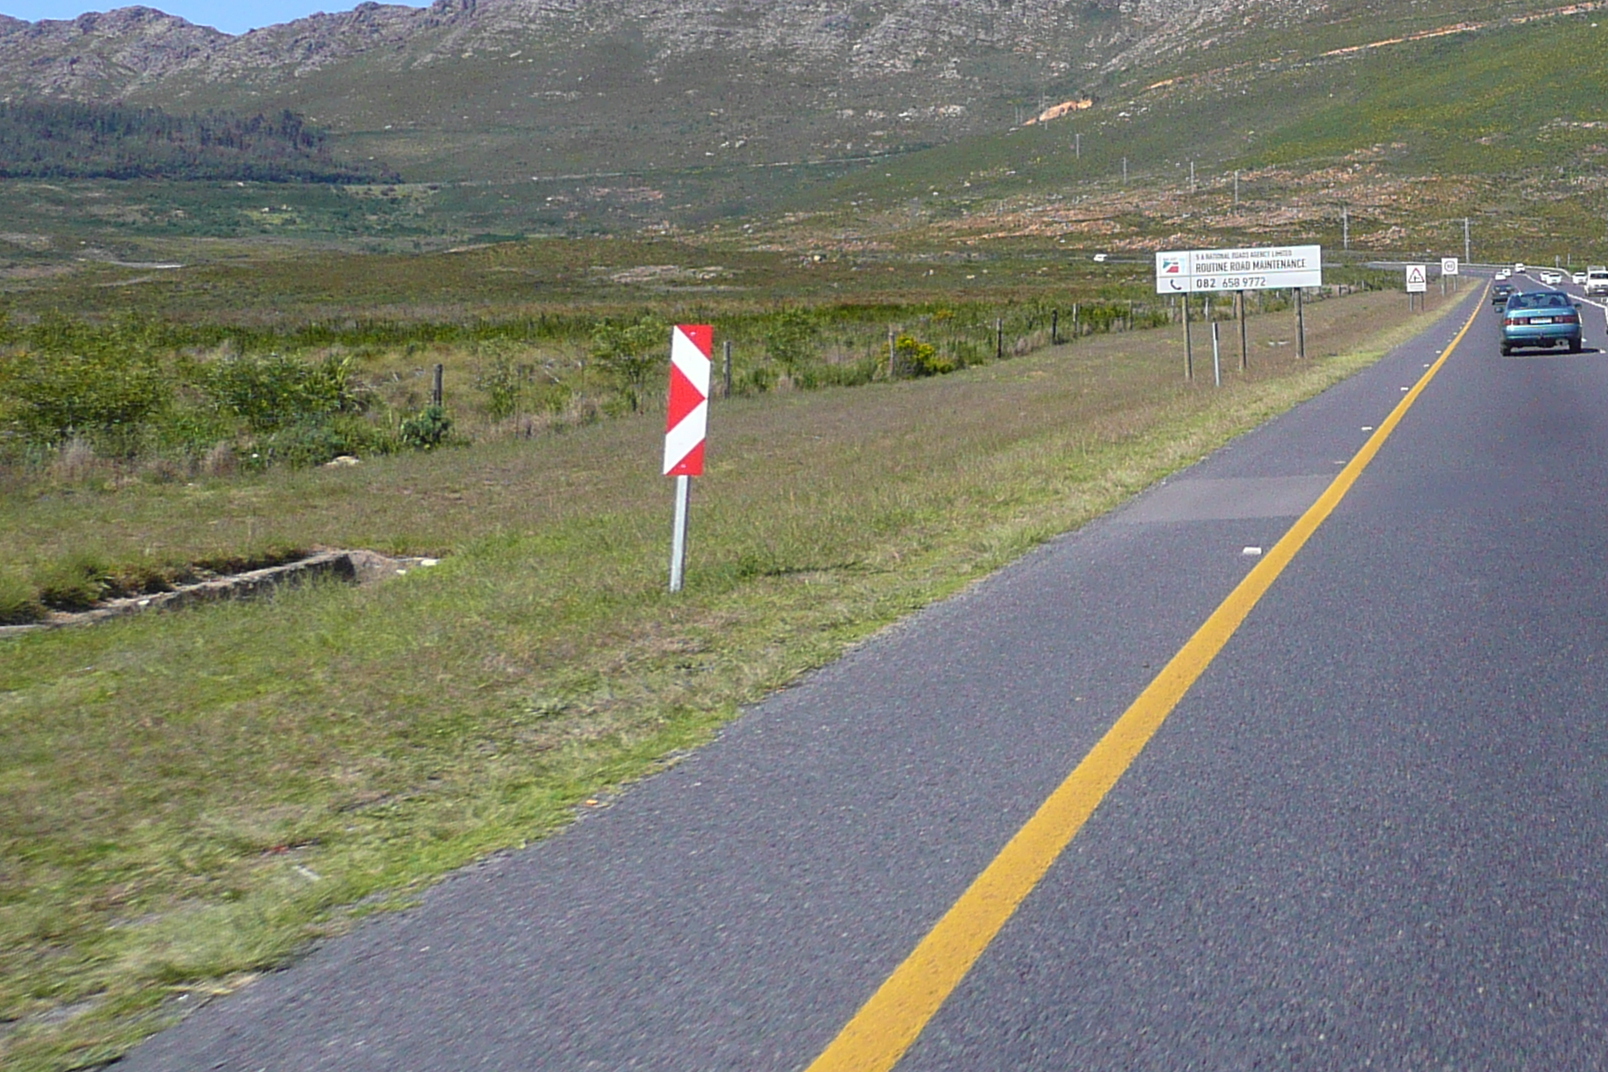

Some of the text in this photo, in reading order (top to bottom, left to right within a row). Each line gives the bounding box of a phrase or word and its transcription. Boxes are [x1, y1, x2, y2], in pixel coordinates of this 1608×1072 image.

[1196, 259, 1306, 273] ROUTINE ROAD MAINTENANCE
[1197, 277, 1266, 288] 082 658 9772
